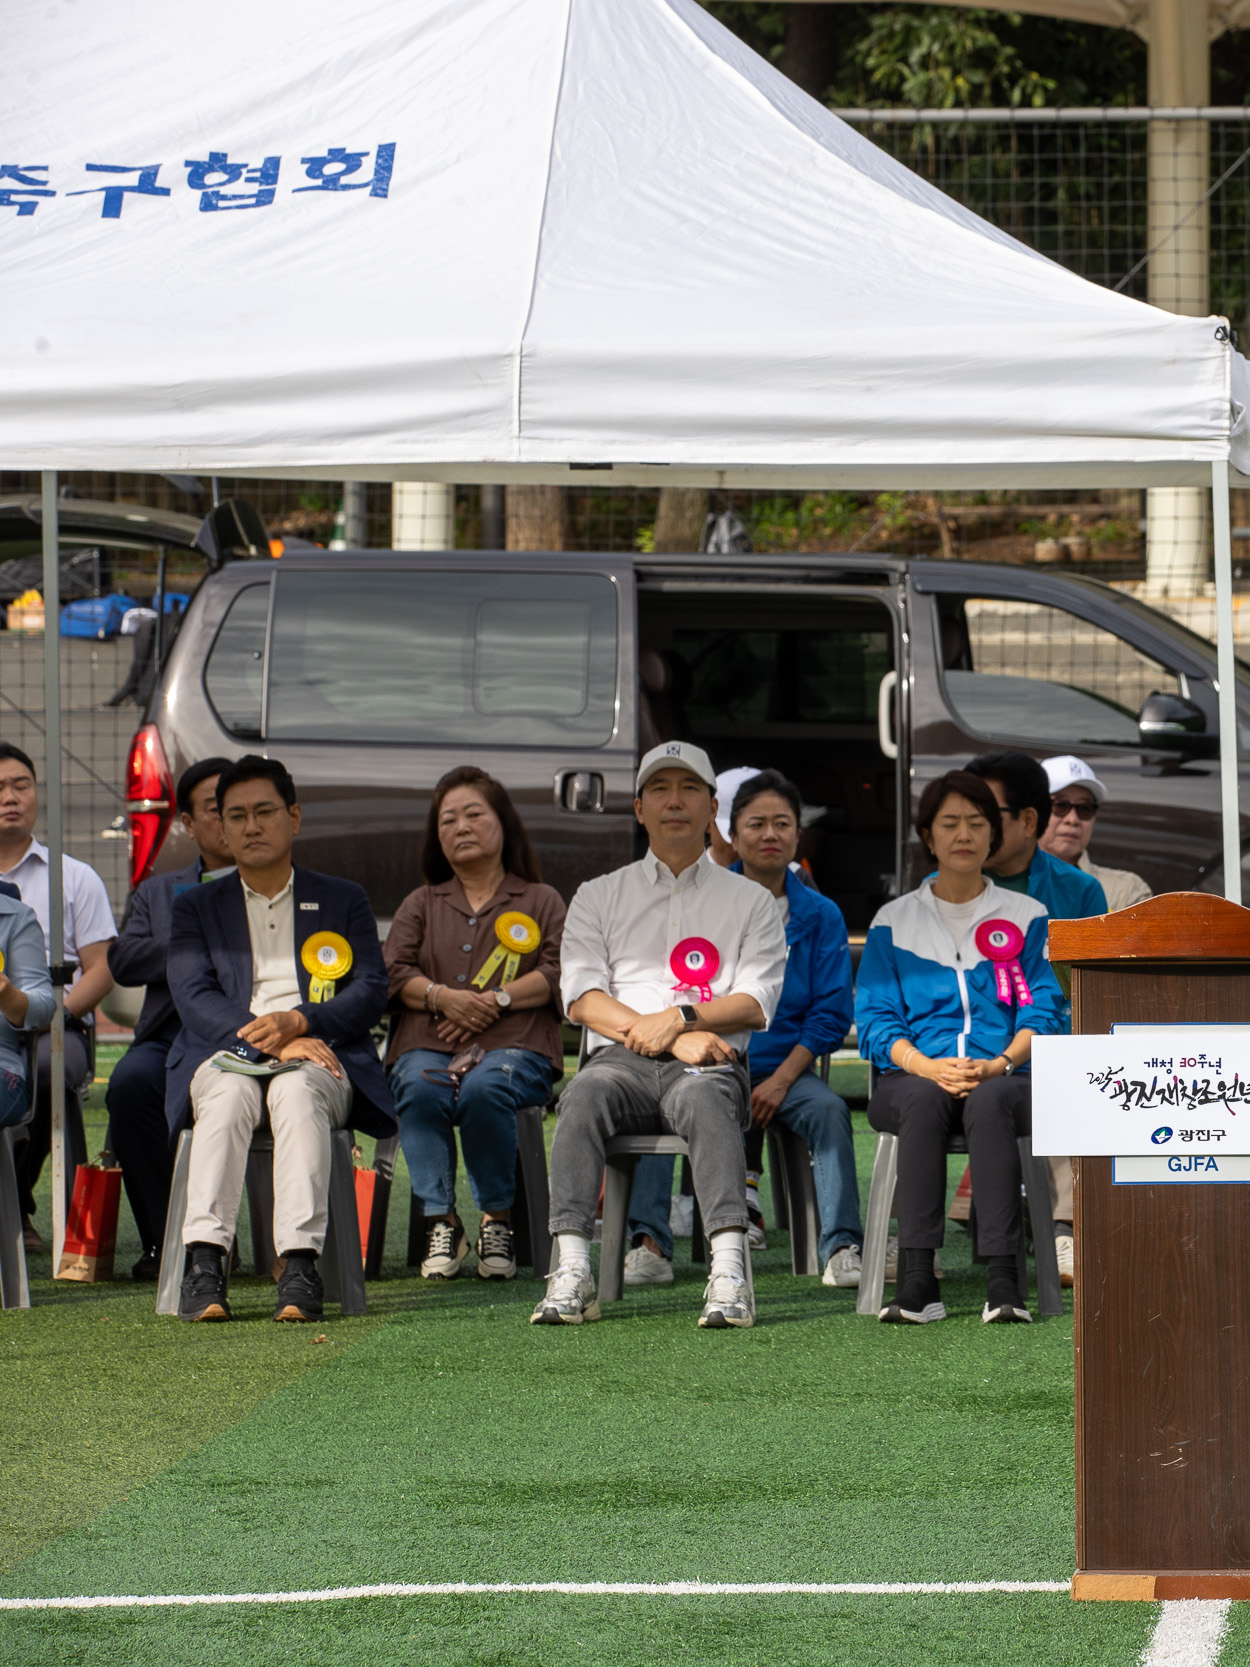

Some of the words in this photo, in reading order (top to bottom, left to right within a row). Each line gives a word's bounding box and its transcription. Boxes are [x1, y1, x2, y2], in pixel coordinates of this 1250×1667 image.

[1143, 1057, 1174, 1075] 개청
[1179, 1054, 1222, 1075] 30주년
[1178, 1129, 1227, 1142] 광진구
[1167, 1156, 1219, 1172] GJFA
